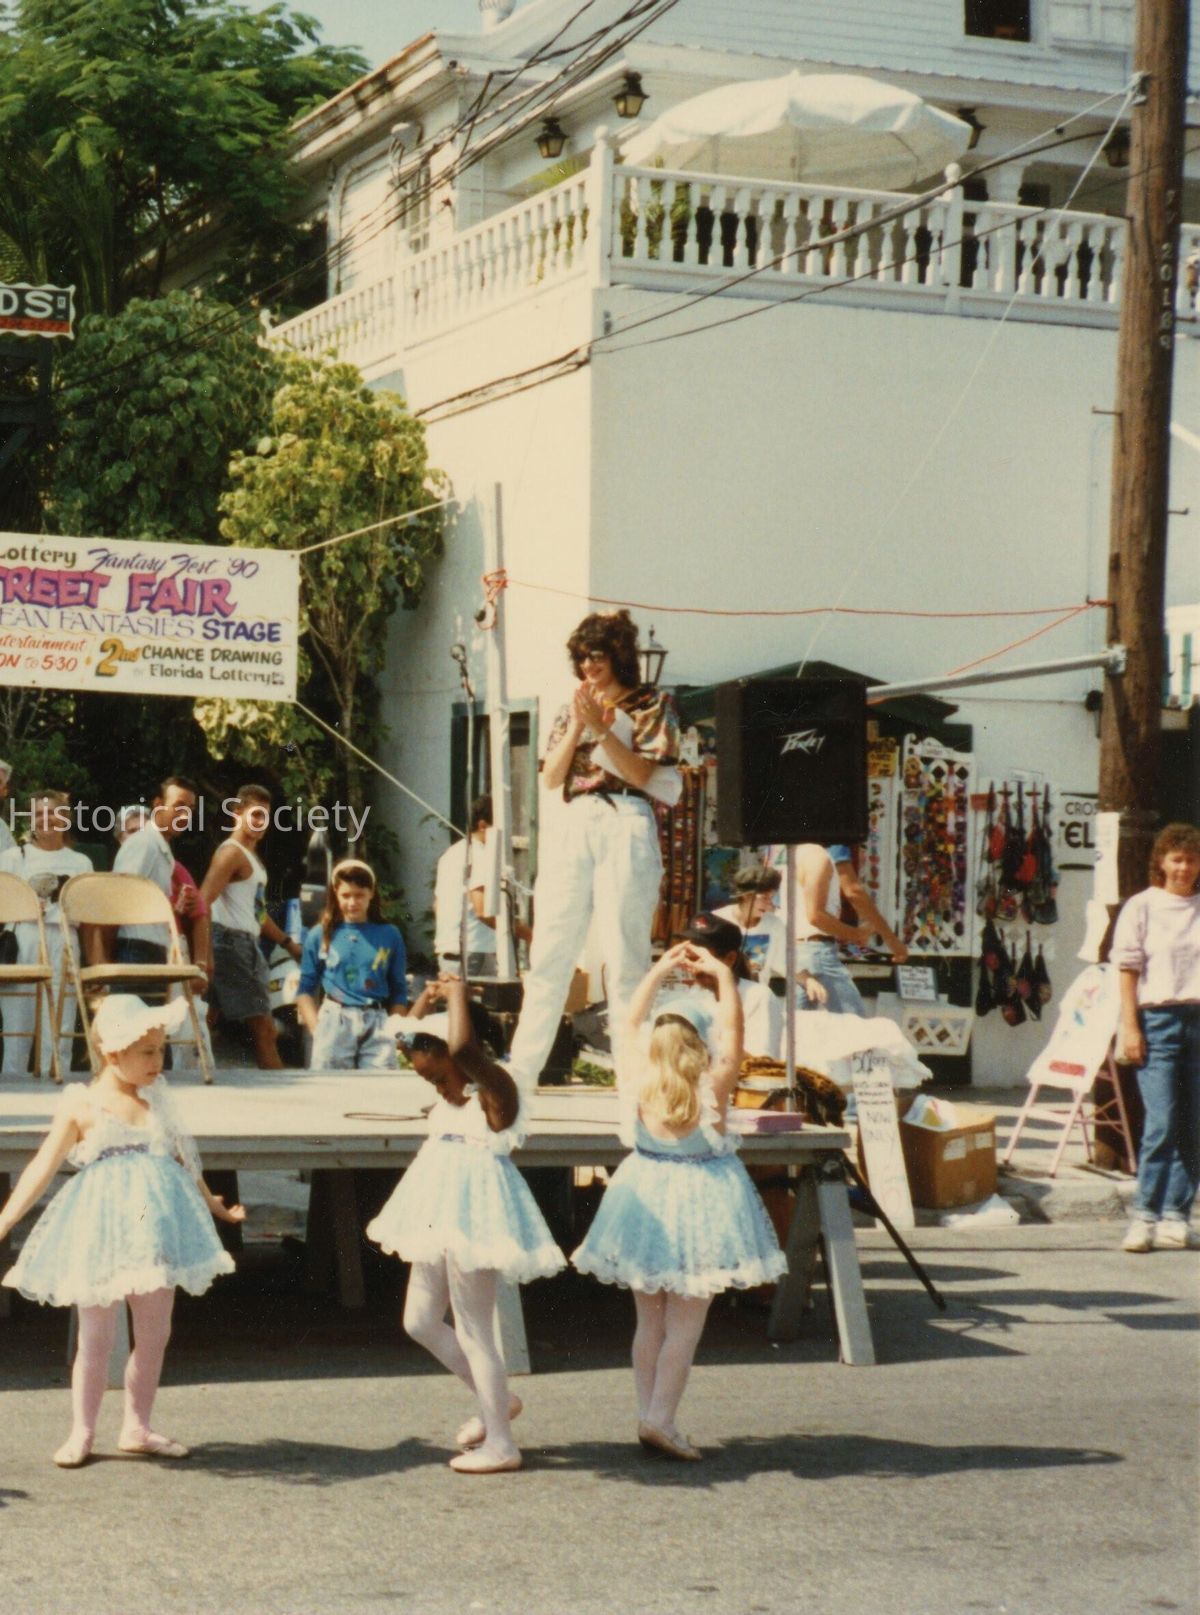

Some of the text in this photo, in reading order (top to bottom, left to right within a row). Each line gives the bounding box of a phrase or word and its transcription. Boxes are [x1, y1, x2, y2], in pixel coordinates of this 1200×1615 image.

[87, 548, 167, 573] Fantasy
[170, 554, 219, 579] Fest
[126, 572, 238, 618] FAIR
[59, 609, 195, 638] FANTASIES
[202, 618, 282, 643] STAGE
[94, 638, 140, 678] 2nd
[141, 644, 283, 666] CHANCE DRAWING
[150, 663, 204, 680] Florida
[210, 666, 273, 686] Lottery
